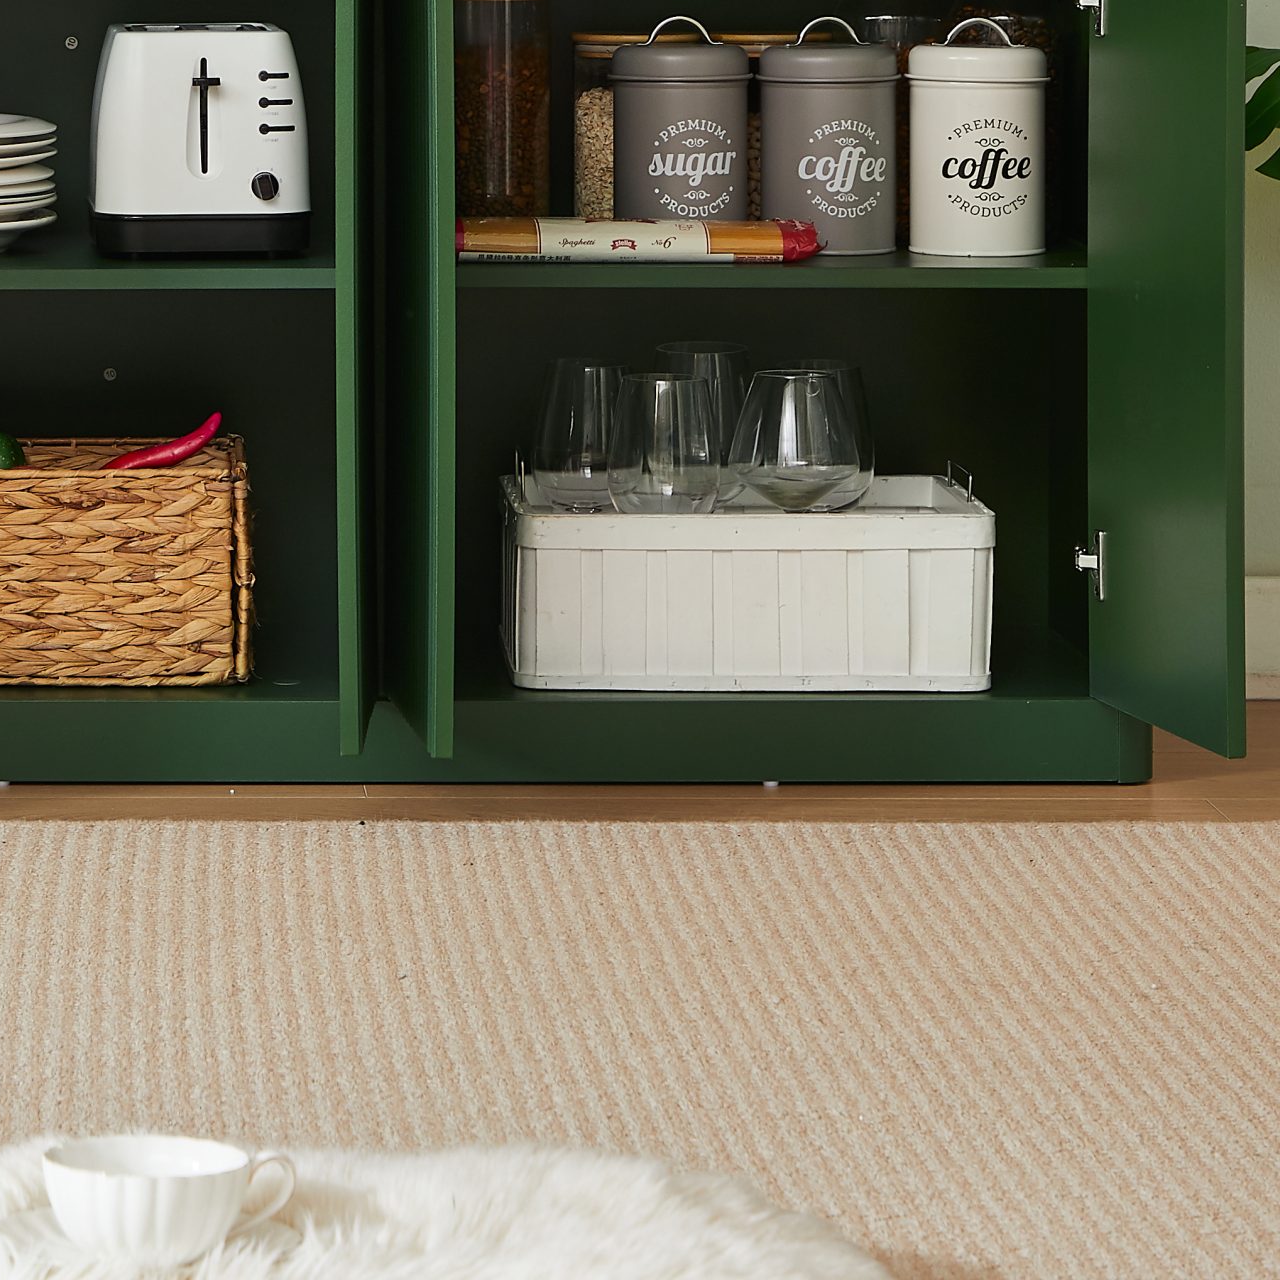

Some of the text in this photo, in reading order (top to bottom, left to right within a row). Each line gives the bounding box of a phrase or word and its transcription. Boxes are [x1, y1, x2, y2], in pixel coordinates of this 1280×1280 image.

[659, 119, 727, 142] PREMIUM
[814, 119, 876, 140] PREMIUM
[953, 119, 1024, 138] PREMIUM
[648, 151, 737, 187] sugar
[798, 146, 887, 193] coffee
[942, 148, 1032, 189] coffee
[659, 192, 730, 217] PRODUCTS
[811, 195, 877, 218] PRODUCTS
[951, 195, 1026, 217] PRODUCTS
[558, 237, 596, 247] Spaghetti
